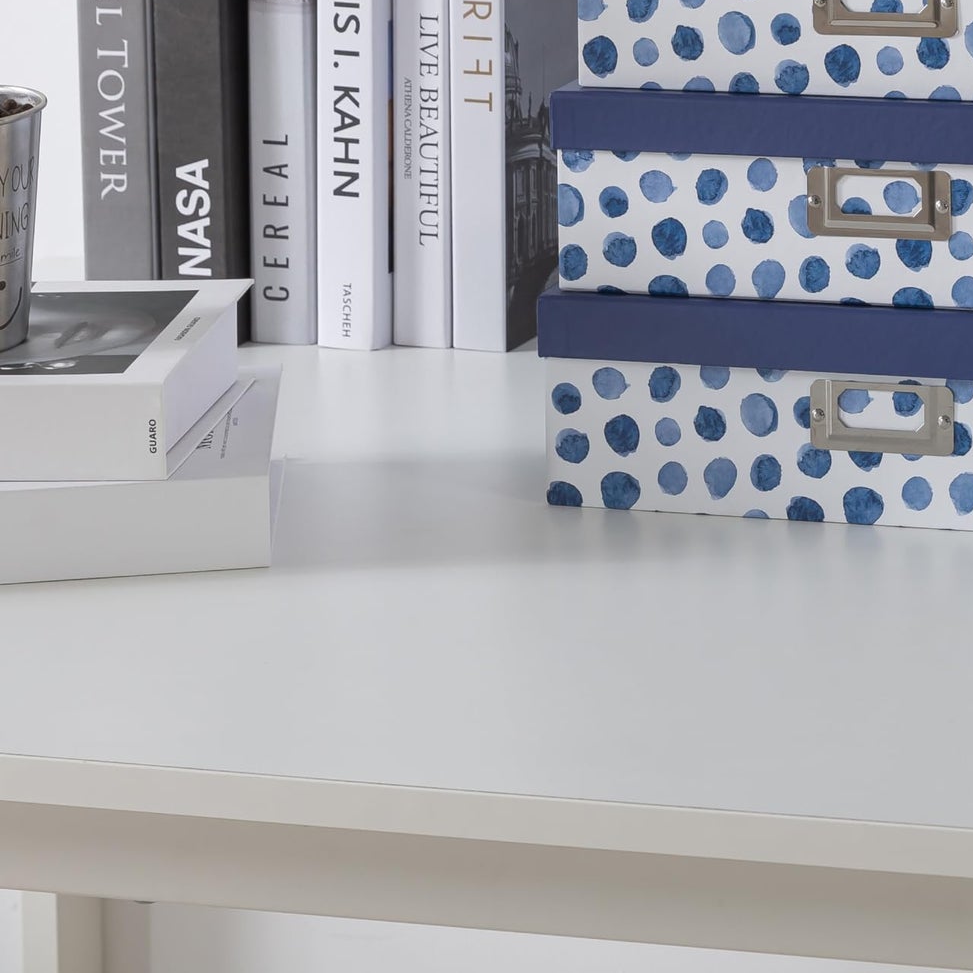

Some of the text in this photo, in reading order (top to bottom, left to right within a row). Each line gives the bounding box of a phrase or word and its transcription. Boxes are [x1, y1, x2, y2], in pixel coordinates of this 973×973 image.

[333, 49, 360, 68] I.
[97, 39, 129, 199] TOWER
[333, 85, 360, 198] KAHN
[404, 77, 412, 180] ATHENA CALDERONE
[419, 13, 439, 246] LIVE BEAUTIFUL
[175, 158, 212, 277] NASA
[262, 134, 289, 301] CEREAL
[148, 419, 157, 454] GUARO
